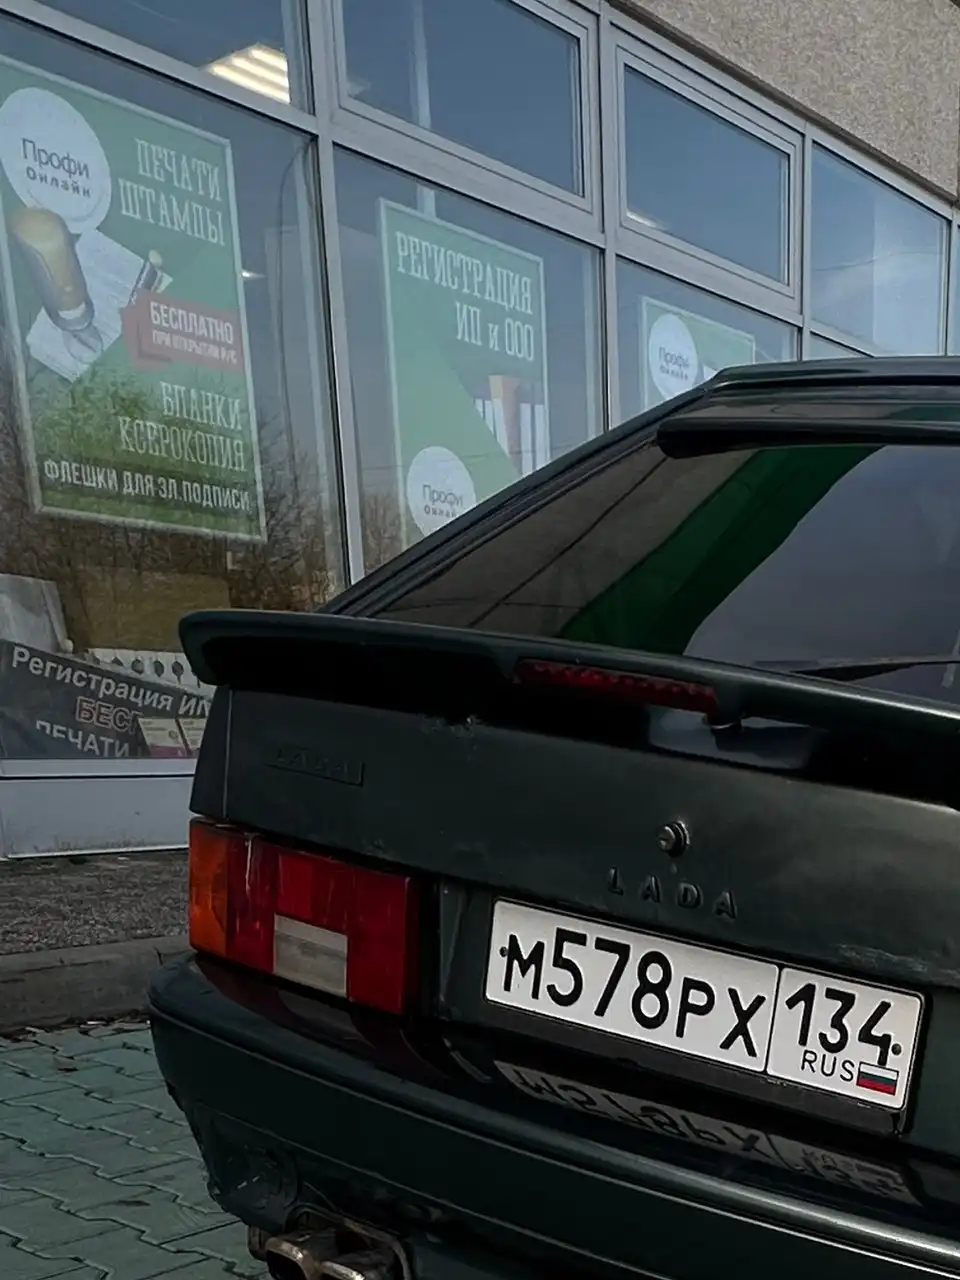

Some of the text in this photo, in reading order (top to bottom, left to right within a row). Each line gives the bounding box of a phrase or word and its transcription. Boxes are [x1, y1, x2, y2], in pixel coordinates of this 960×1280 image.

[21, 137, 90, 179] Профи
[134, 137, 222, 201] ПЕЧАТИ
[118, 177, 225, 246] ШТАМПЫ
[394, 230, 533, 315] РЕГИСТРАЦИЯ
[150, 300, 234, 344] БЕСПЛАТНО
[455, 301, 483, 346] ИП
[504, 318, 534, 362] ООО
[118, 415, 247, 471] КСЕРОКОПИЯ
[43, 459, 119, 492] ФЛЕШКИ
[122, 470, 155, 497] ДЛЯ
[12, 645, 174, 711] Регистрация
[605, 866, 738, 920] LADA
[503, 927, 893, 1066] М578РХ 134
[801, 1049, 855, 1082] RUS
